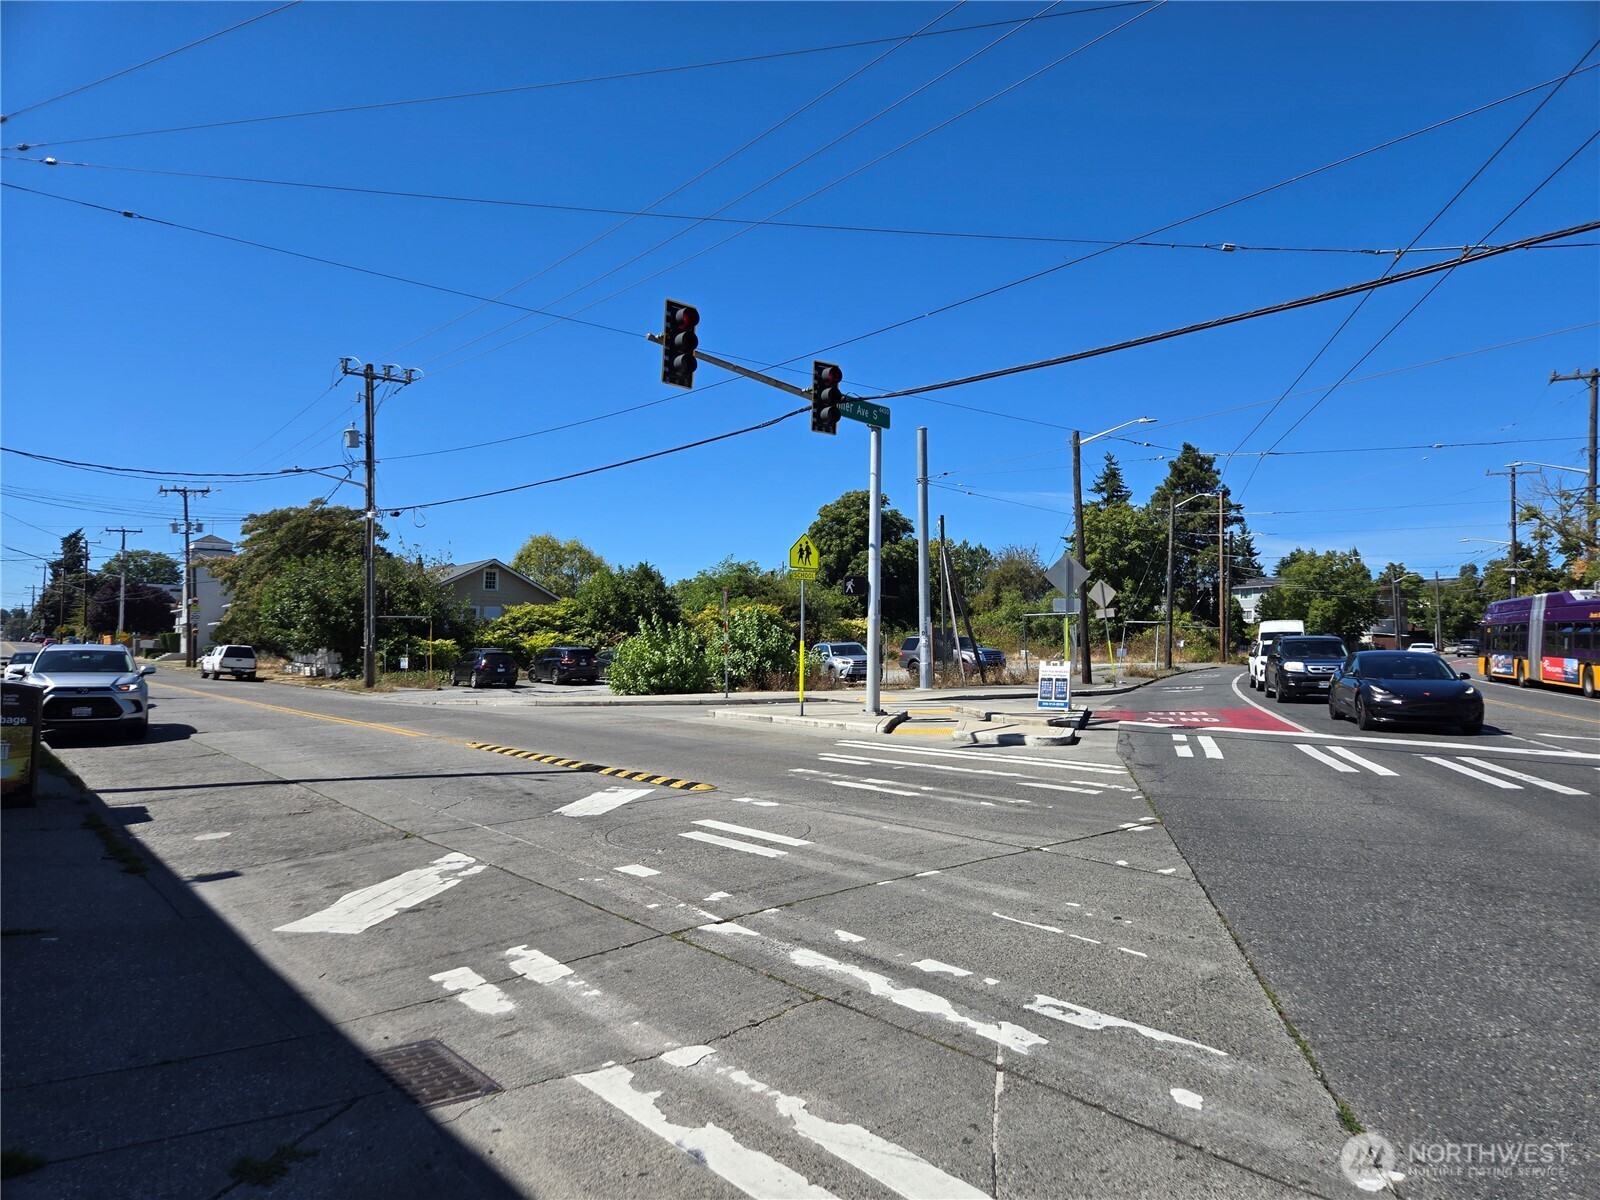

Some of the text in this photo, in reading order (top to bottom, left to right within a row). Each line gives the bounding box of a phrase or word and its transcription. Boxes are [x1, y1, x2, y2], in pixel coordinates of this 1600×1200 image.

[856, 405, 869, 417] Ave
[872, 409, 878, 420] S
[878, 407, 889, 415] 4400
